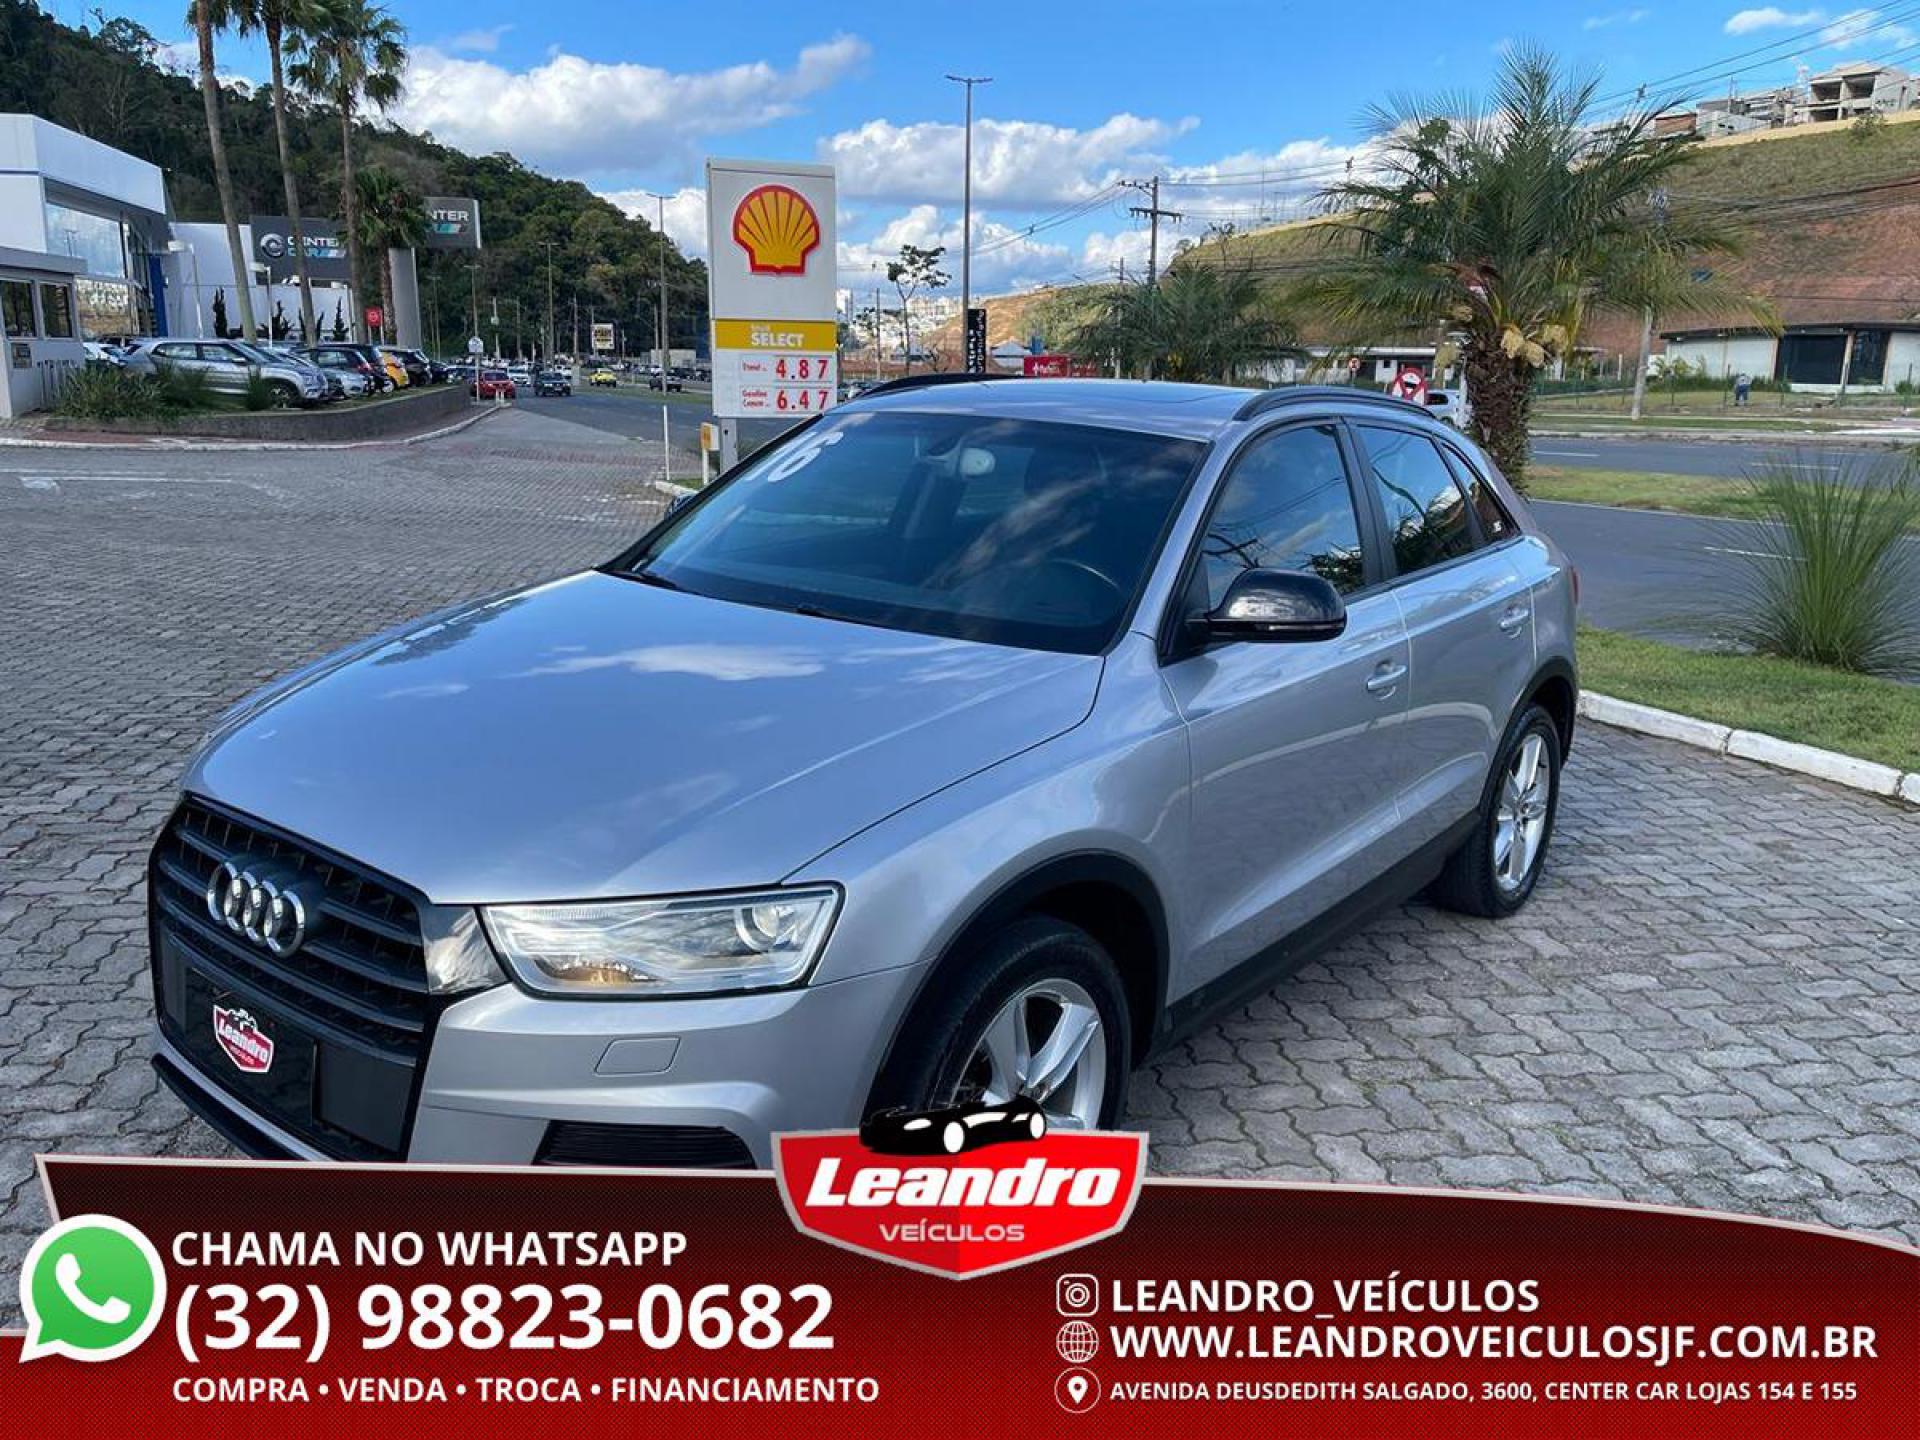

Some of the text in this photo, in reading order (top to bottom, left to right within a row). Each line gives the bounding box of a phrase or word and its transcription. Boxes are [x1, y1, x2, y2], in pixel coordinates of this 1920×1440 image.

[431, 209, 469, 221] NTER
[751, 331, 805, 348] SELECT
[775, 359, 828, 379] 4.87
[776, 389, 828, 410] 6.47
[219, 1017, 269, 1064] Leandro
